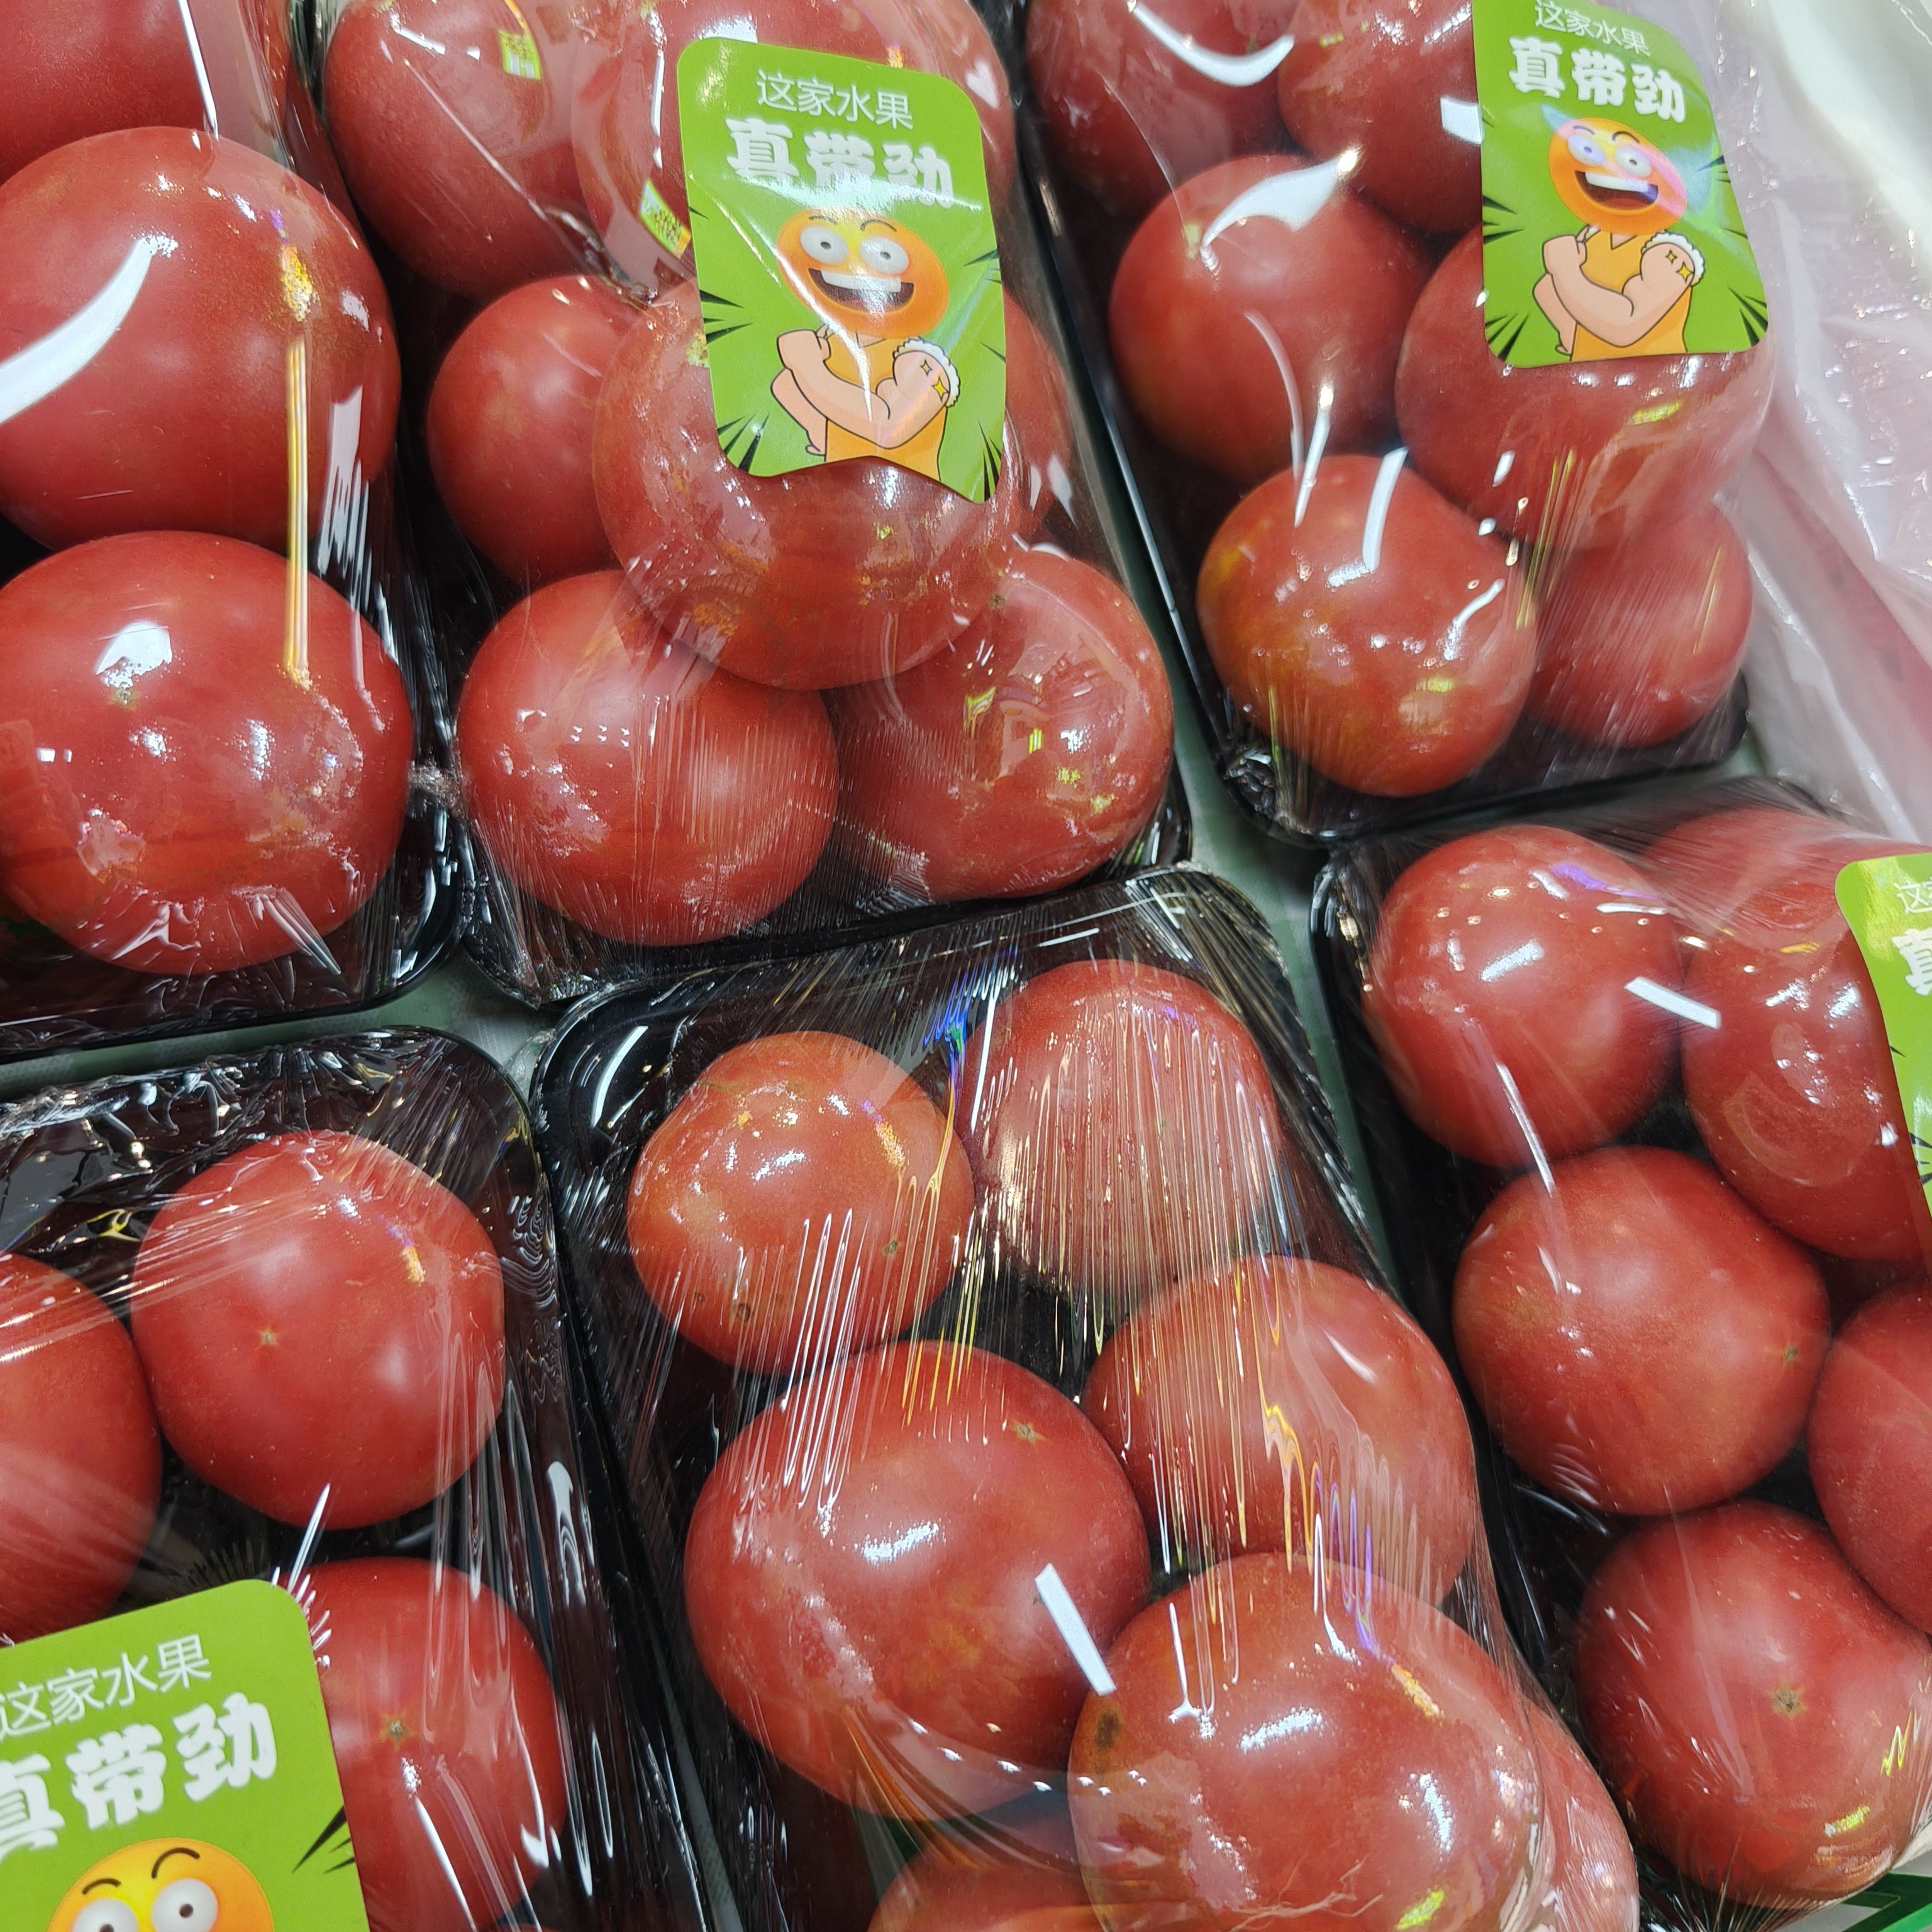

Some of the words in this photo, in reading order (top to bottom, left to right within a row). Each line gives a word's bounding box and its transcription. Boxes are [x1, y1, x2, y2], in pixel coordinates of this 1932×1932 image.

[1535, 0, 1651, 57] 这家水果
[757, 70, 913, 130] 这家水果
[1509, 36, 1685, 123] 真带劲
[725, 118, 953, 209] 真带劲
[0, 1633, 212, 1741] 这家水果
